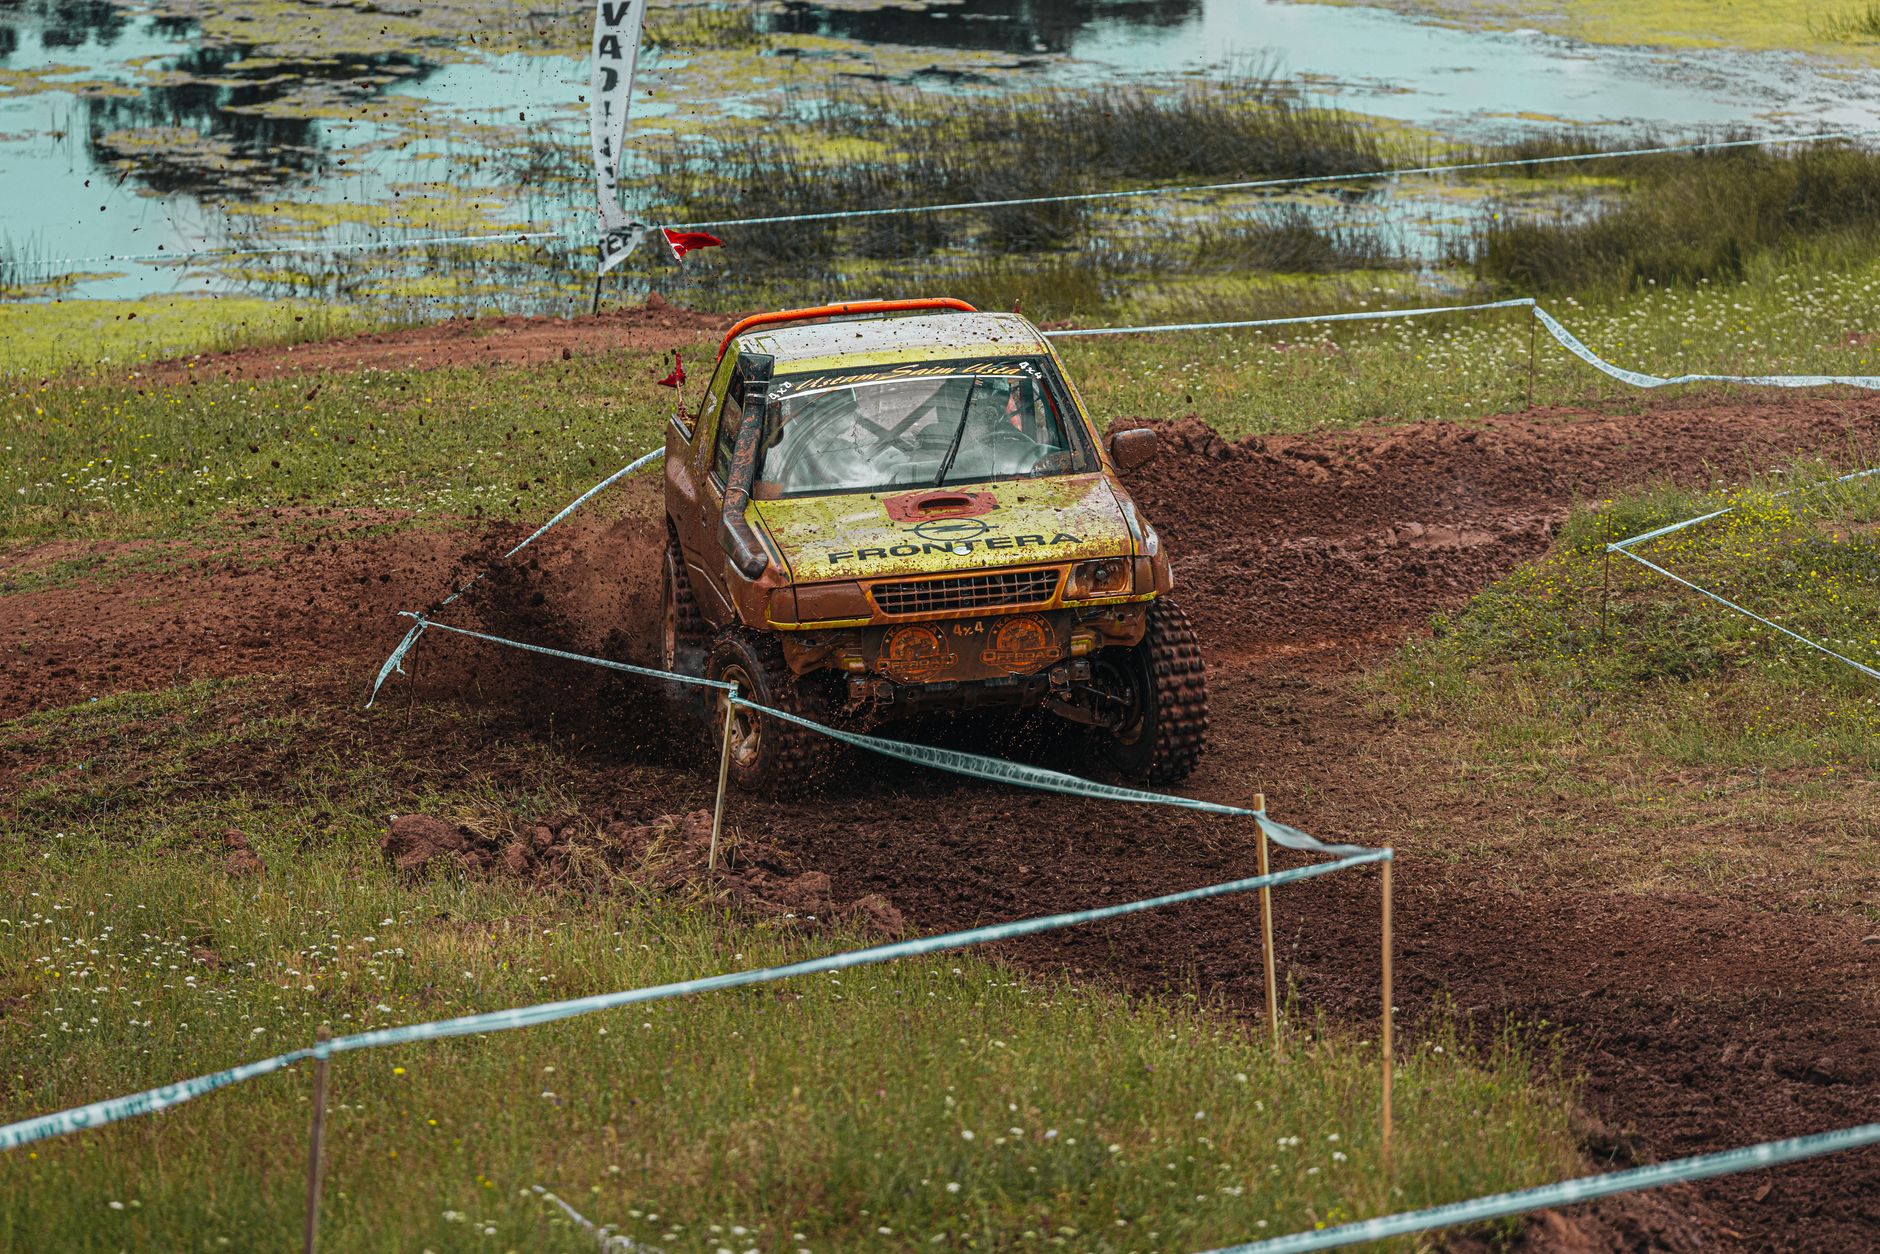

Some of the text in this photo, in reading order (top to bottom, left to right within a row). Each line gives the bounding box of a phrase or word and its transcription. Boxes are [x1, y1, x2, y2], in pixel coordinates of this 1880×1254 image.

[1018, 361, 1042, 379] 4x4
[828, 533, 1084, 564] FRONTERA
[953, 620, 985, 637] 4x4
[982, 648, 1061, 662] OFFROAD
